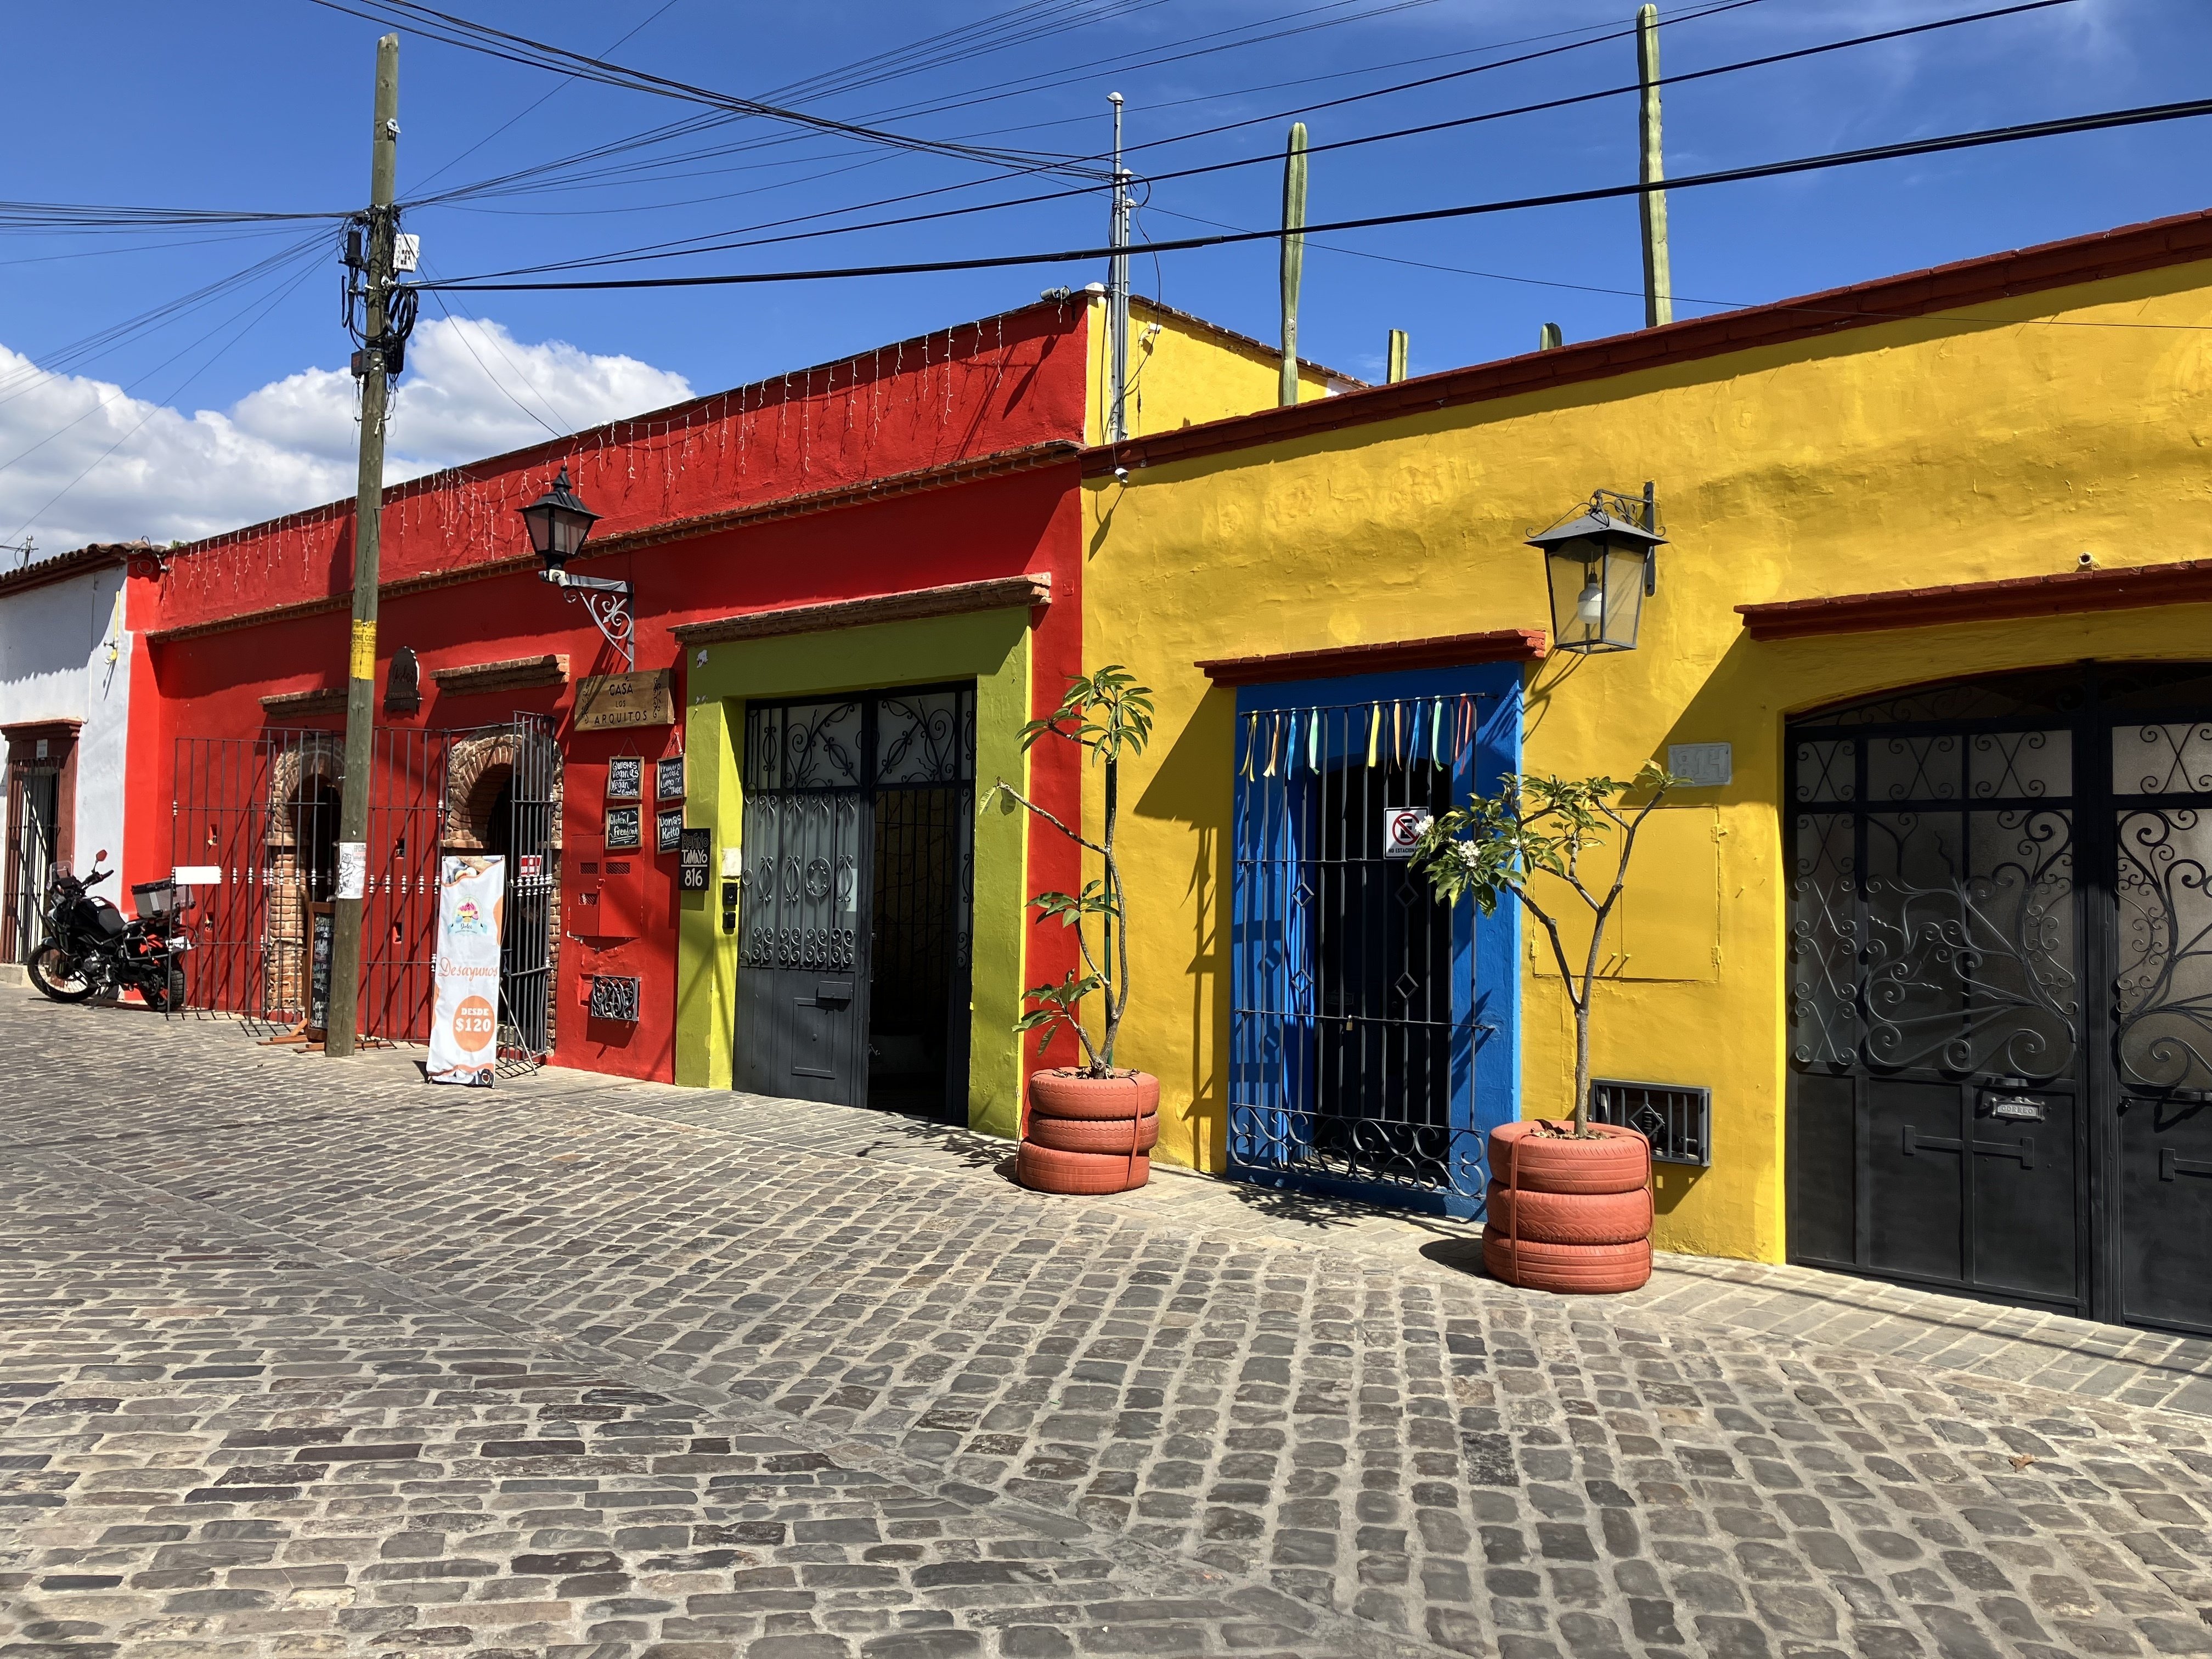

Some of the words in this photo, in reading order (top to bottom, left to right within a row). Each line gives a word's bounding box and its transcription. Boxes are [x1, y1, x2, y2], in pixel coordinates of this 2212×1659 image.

[609, 684, 633, 696] CASA
[594, 710, 647, 725] ARQUITOS
[685, 868, 703, 887] 816
[438, 957, 499, 981] Desayunos
[461, 1008, 489, 1016] DESDE
[455, 1018, 492, 1032] $120
[2001, 1105, 2034, 1114] CORREO
